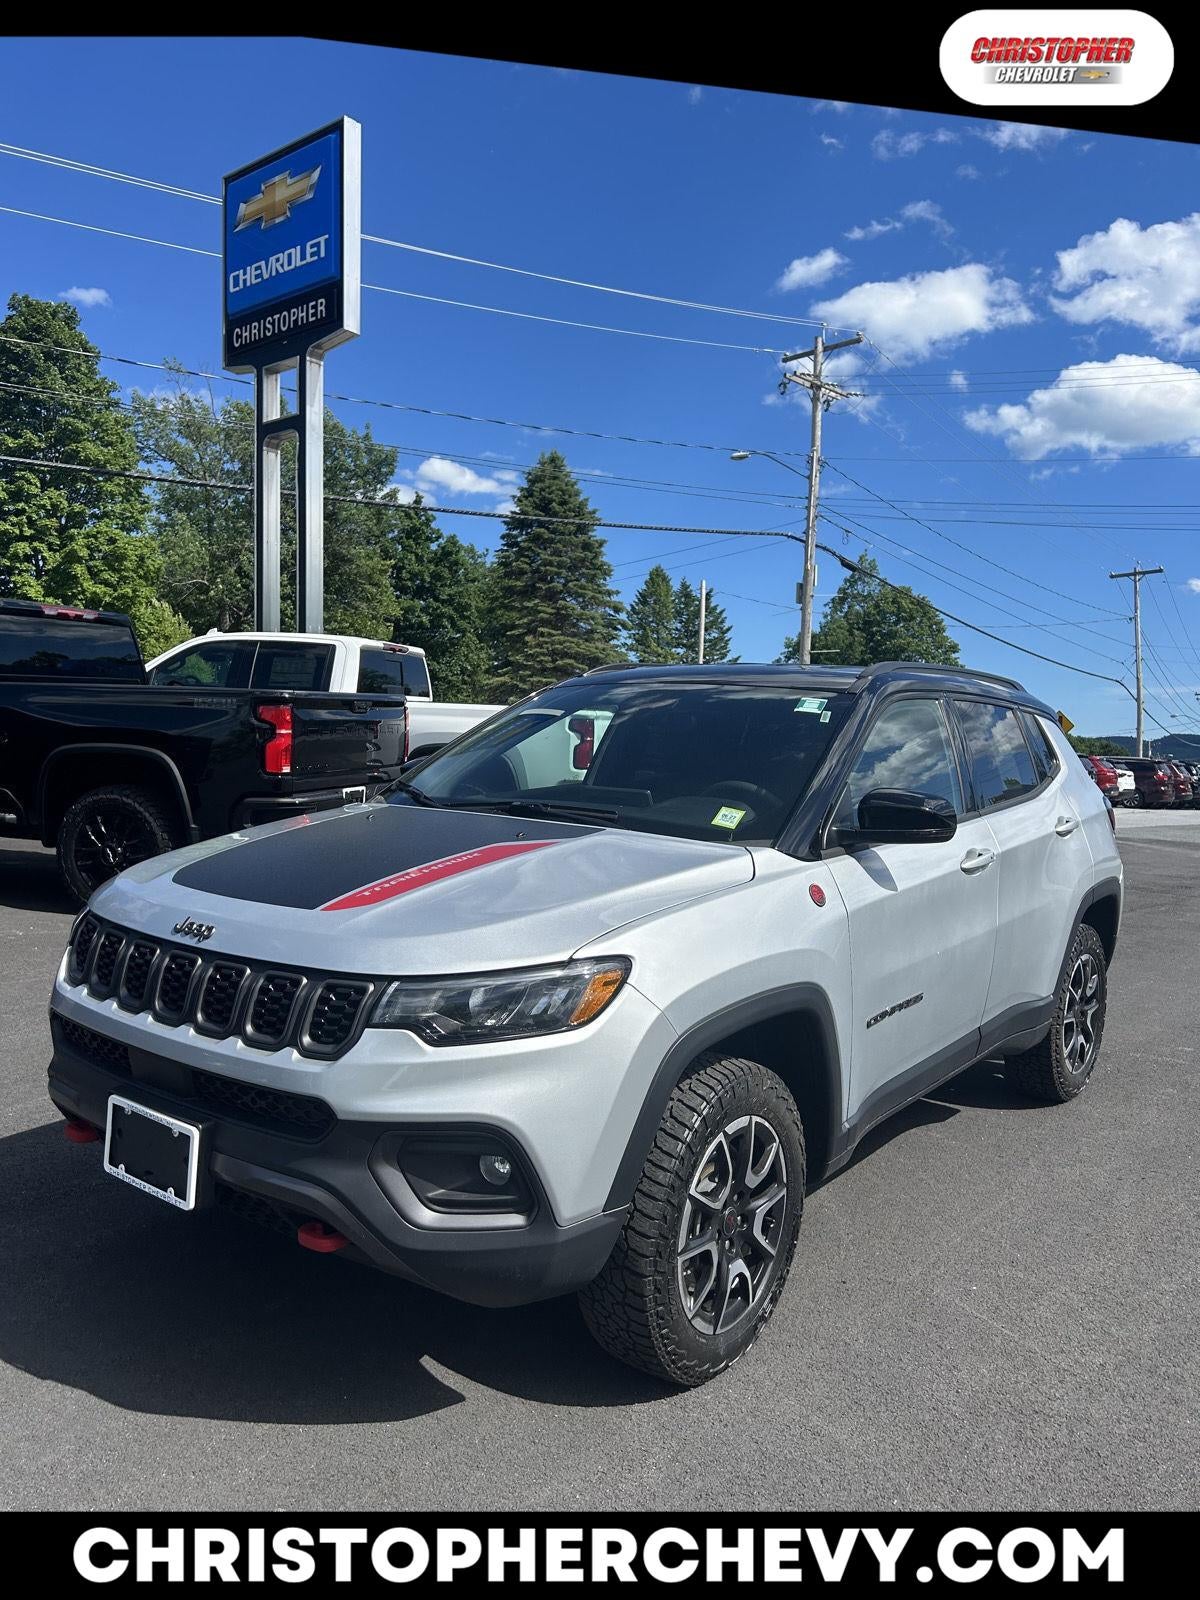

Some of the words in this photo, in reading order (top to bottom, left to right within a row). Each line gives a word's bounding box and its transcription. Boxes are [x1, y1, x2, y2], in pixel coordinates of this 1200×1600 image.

[229, 234, 329, 293] CHEVROLET
[233, 298, 326, 348] CHRISTOPHER
[173, 916, 216, 943] Jeep
[109, 1167, 147, 1190] CHRISTOPHER
[148, 1186, 182, 1207] CHEVROLET
